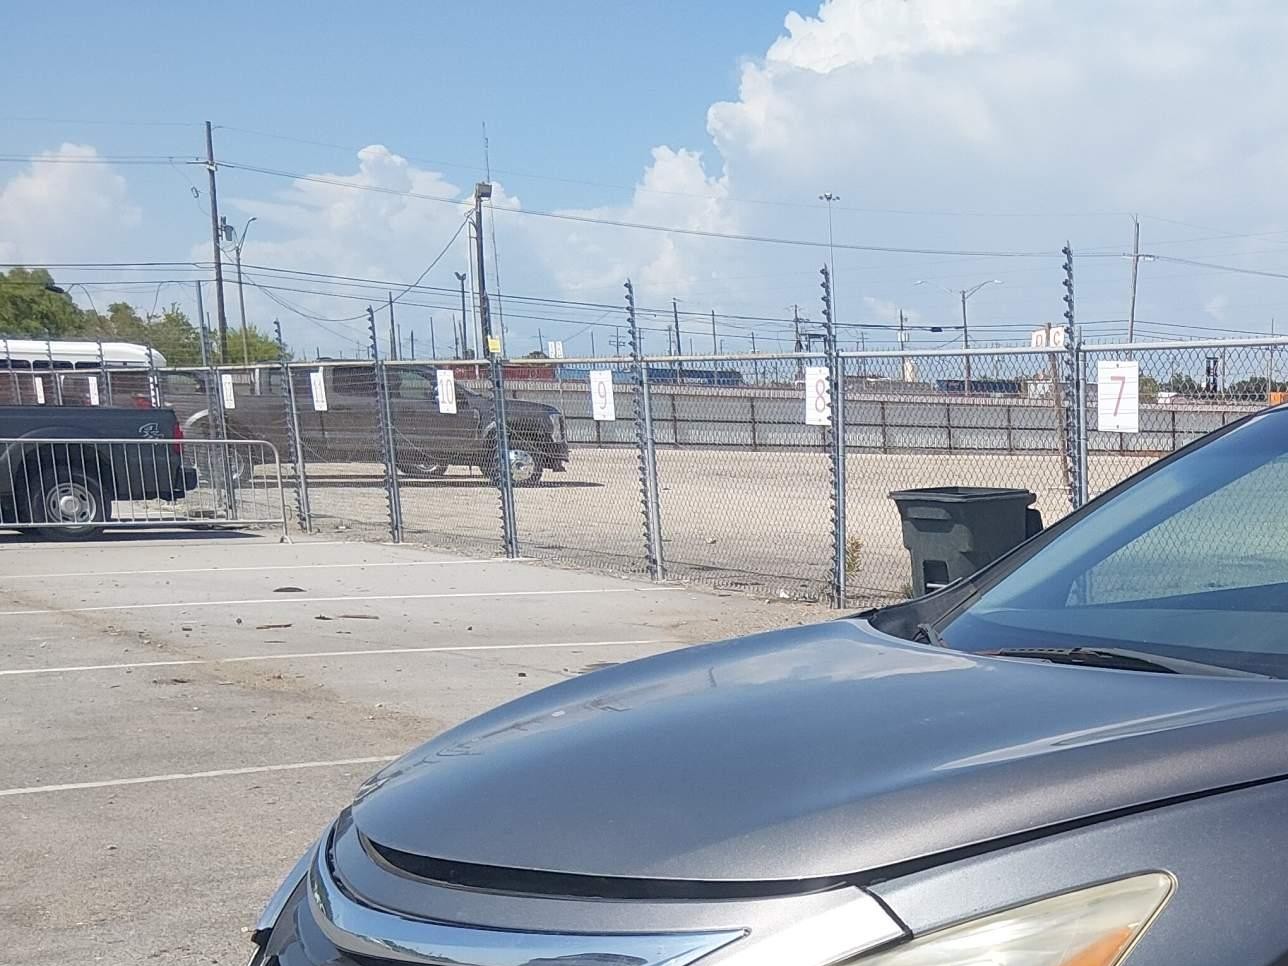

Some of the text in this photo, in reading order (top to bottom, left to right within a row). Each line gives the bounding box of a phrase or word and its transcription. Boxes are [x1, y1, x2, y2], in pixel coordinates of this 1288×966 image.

[1053, 330, 1061, 346] C
[440, 378, 454, 404] 10
[598, 380, 607, 410] 9
[815, 378, 826, 413] 8
[1110, 376, 1126, 417] 7
